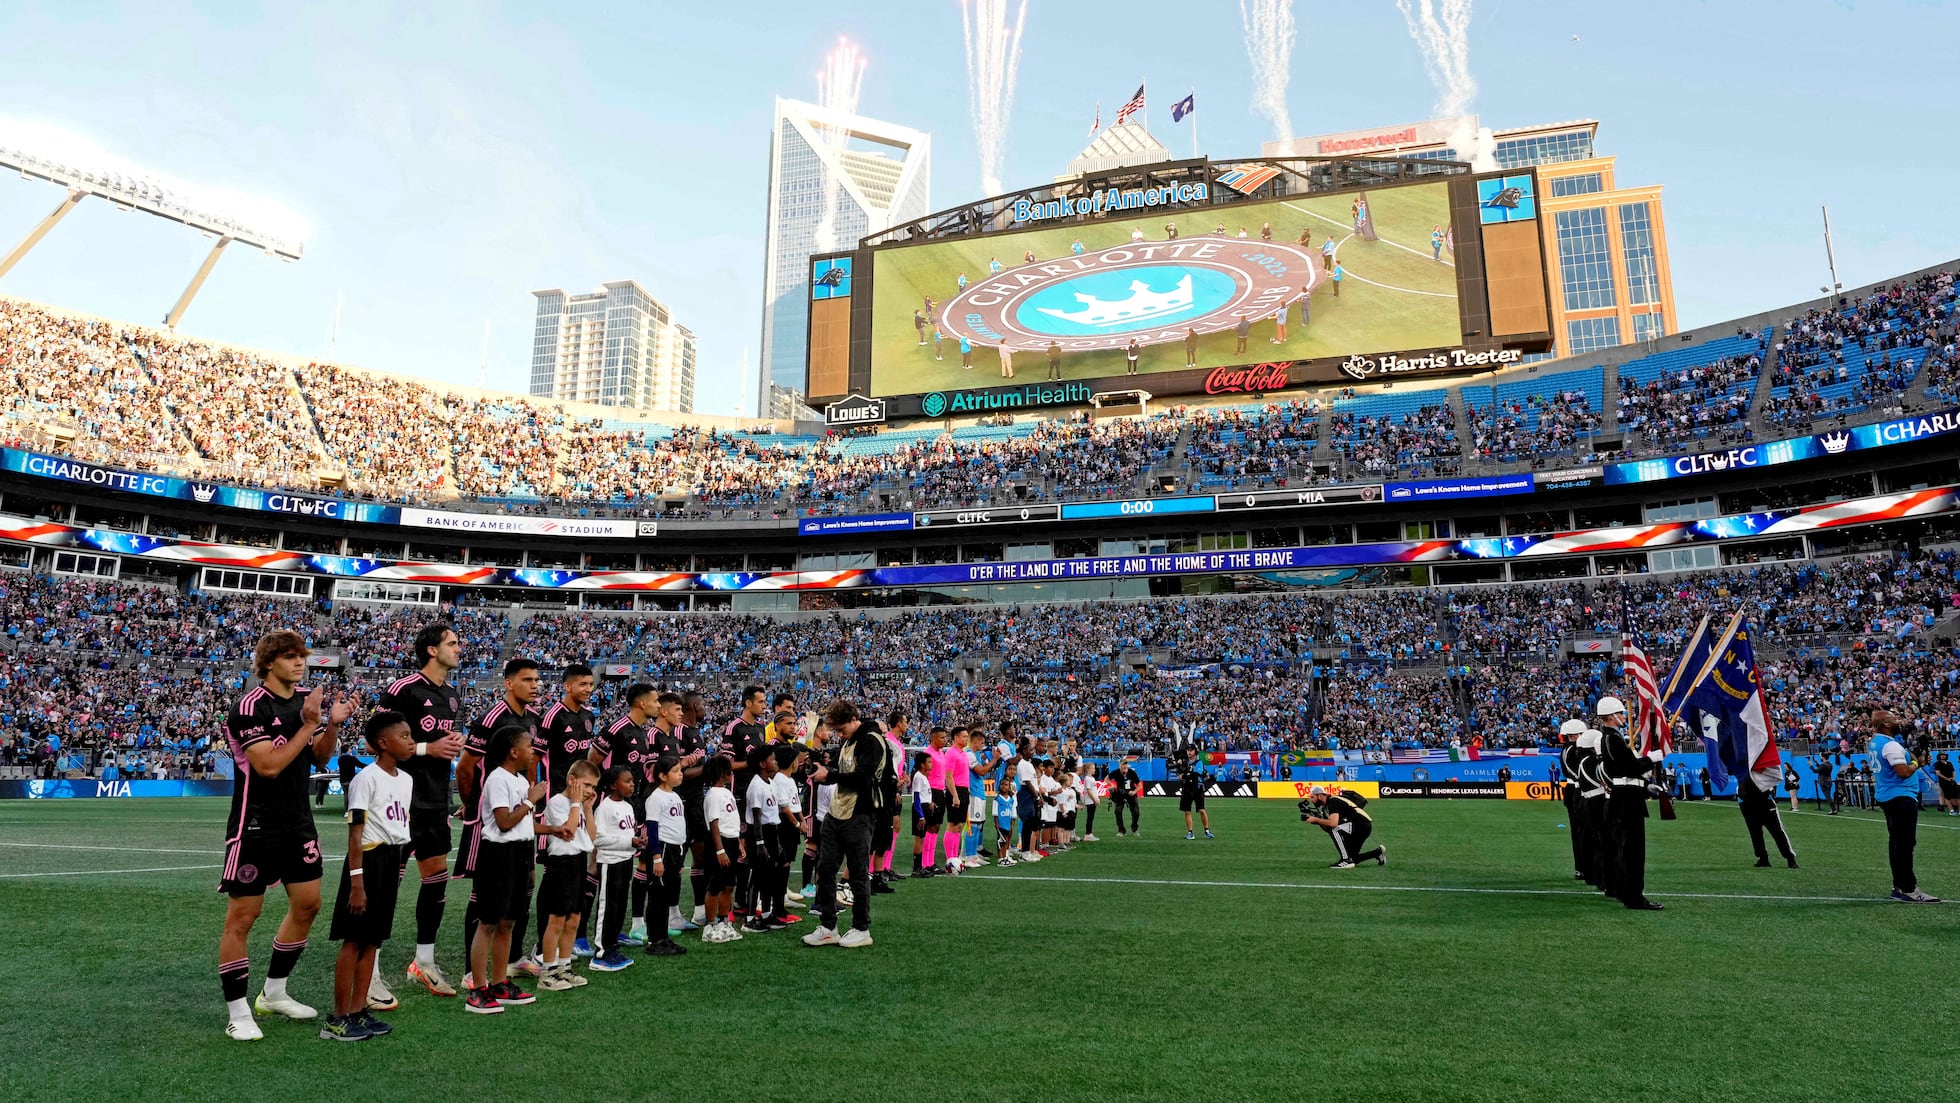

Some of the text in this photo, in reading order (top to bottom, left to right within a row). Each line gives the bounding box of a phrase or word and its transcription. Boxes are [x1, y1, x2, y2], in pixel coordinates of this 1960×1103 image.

[1319, 128, 1416, 153] Honeywell
[1014, 180, 1208, 222] Bank of America
[967, 243, 1227, 306] CHARLOTTE
[1246, 253, 1289, 276] 2022
[1230, 285, 1292, 317] CLUB
[1379, 349, 1521, 373] Harris Teeter
[1205, 361, 1294, 394] Coca-Cola
[951, 382, 1091, 411] Atrium Health
[830, 404, 880, 422] LOWE'S
[1883, 411, 1960, 441] CHARL
[28, 457, 166, 494] CHARLOTTE FC
[1246, 491, 1325, 507] 0 MIA
[1415, 480, 1528, 495] Lowe's Knows Home Improvement
[957, 508, 1030, 524] CLTFC 0
[1121, 501, 1154, 514] 0:00
[426, 516, 459, 527] BANK
[462, 520, 477, 529] OF
[562, 525, 613, 535] STADIUM
[858, 520, 874, 528] Home
[874, 518, 909, 527] Improvement
[970, 551, 1293, 580] O'ER THE LAND OF THE FREE AND THE HOME OF THE BRAVE
[1723, 649, 1736, 664] N
[95, 780, 132, 798] MIA
[1430, 787, 1460, 795] HENDRICK
[1479, 787, 1505, 795] DEALERS
[386, 800, 408, 828] ally
